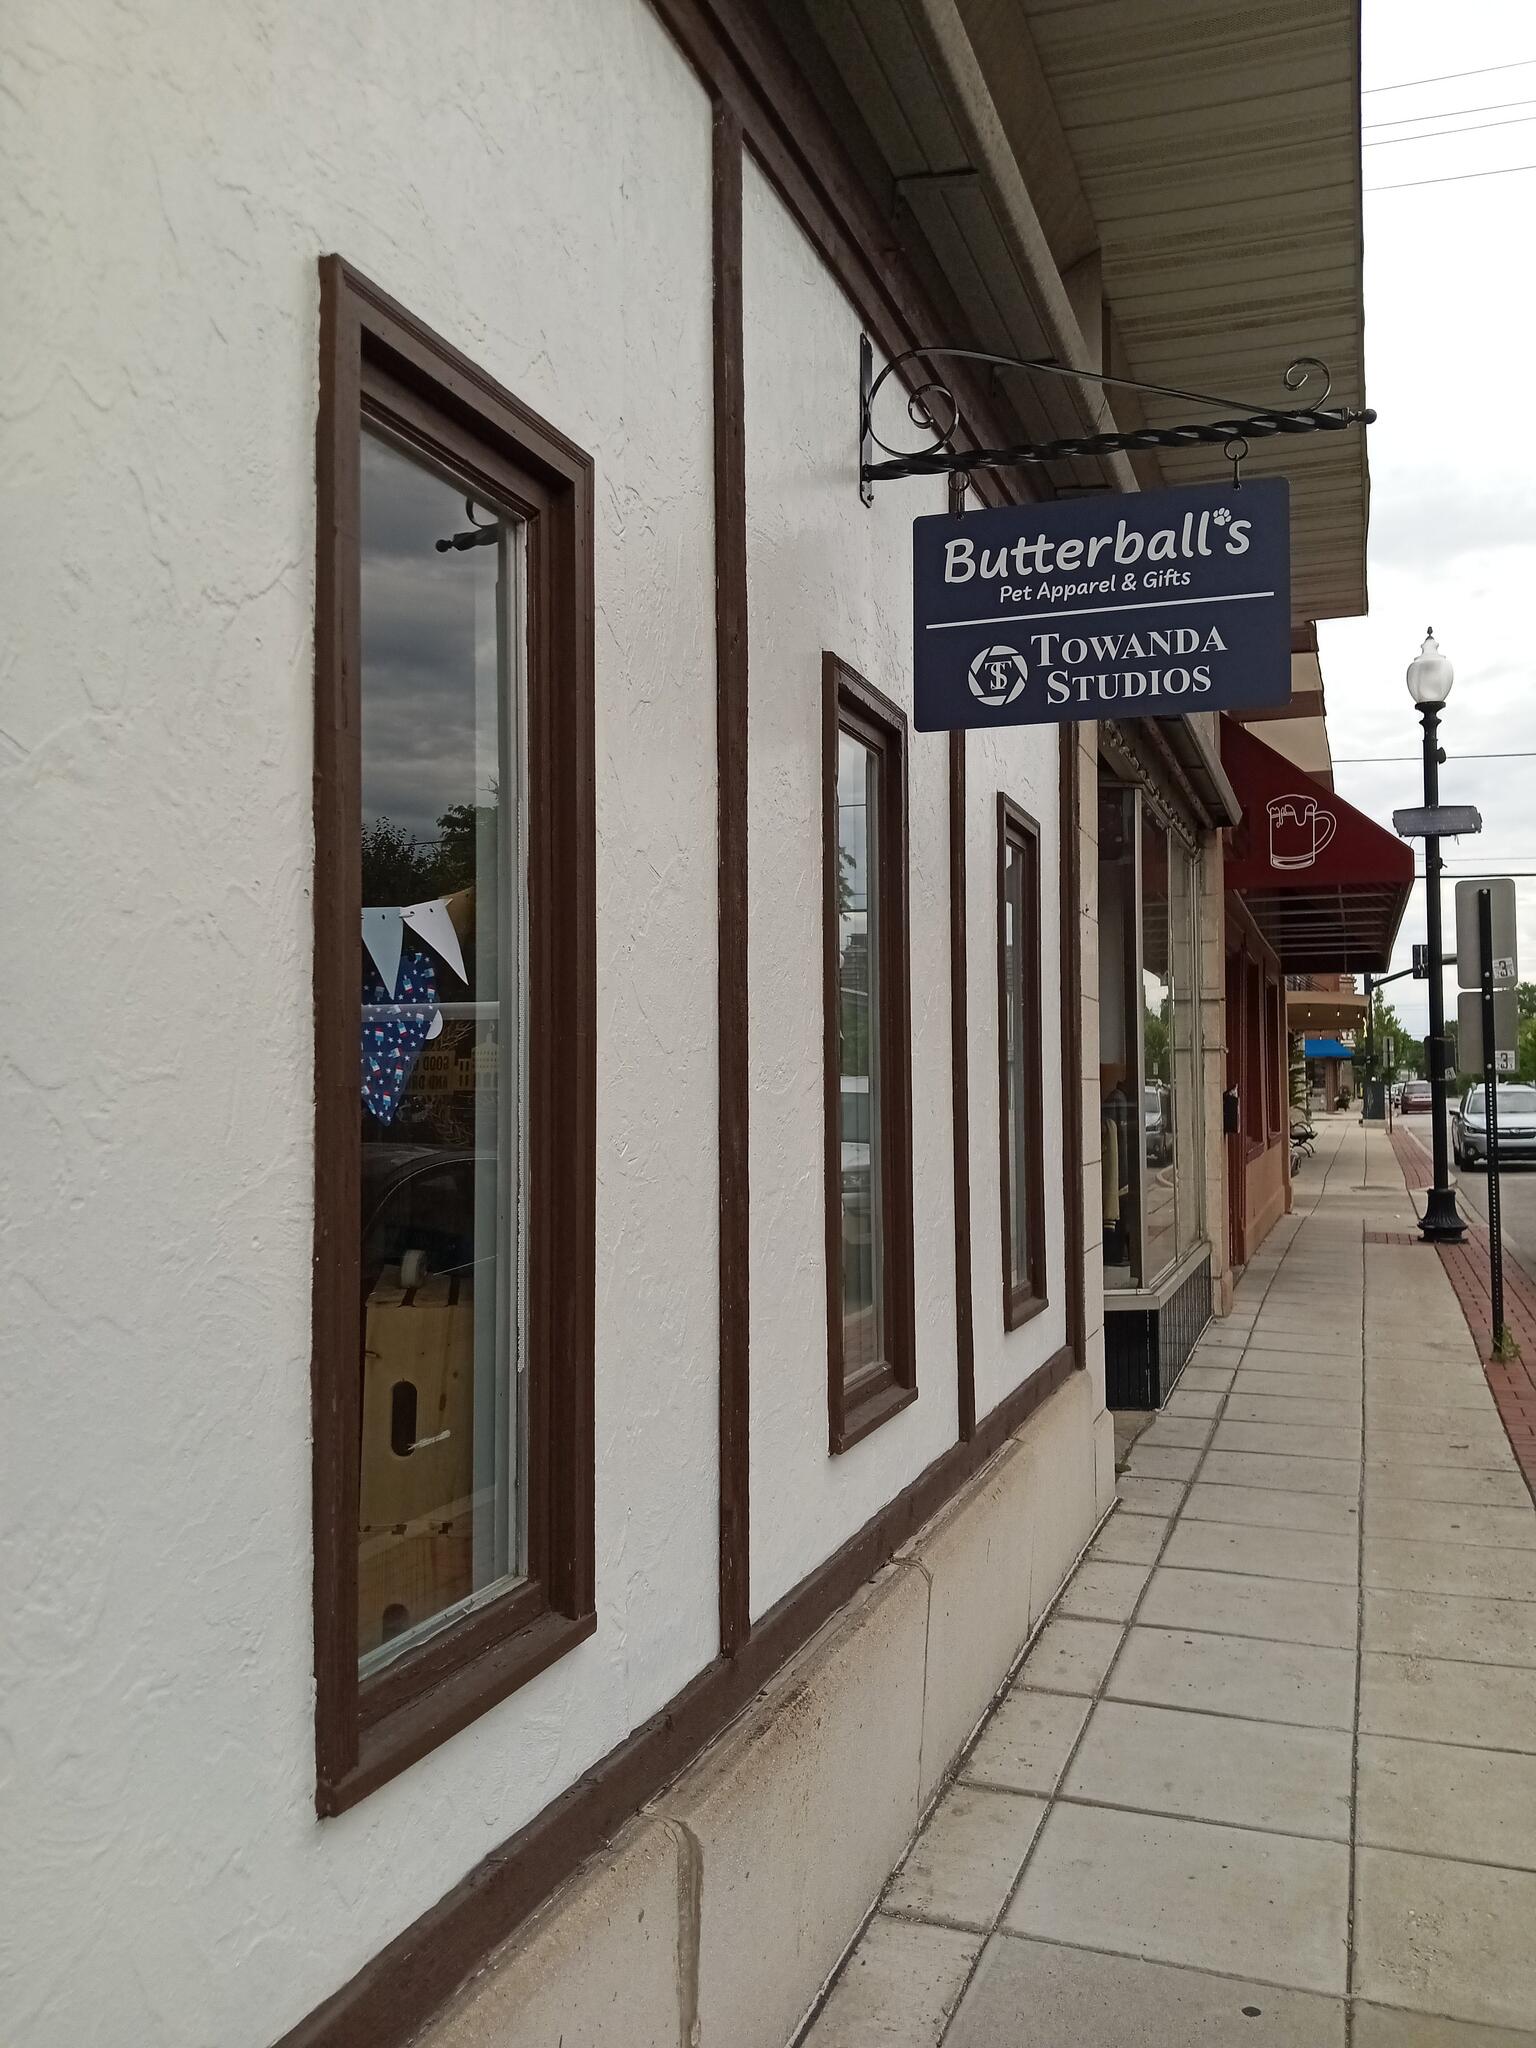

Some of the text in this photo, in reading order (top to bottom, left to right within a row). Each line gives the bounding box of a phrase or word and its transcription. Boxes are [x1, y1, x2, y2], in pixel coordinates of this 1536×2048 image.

[944, 508, 1252, 584] Butterball's
[1001, 568, 1192, 604] Pet Apparel & Gifts
[1030, 625, 1228, 667] TOWANDA
[1047, 665, 1212, 705] STUDIOS
